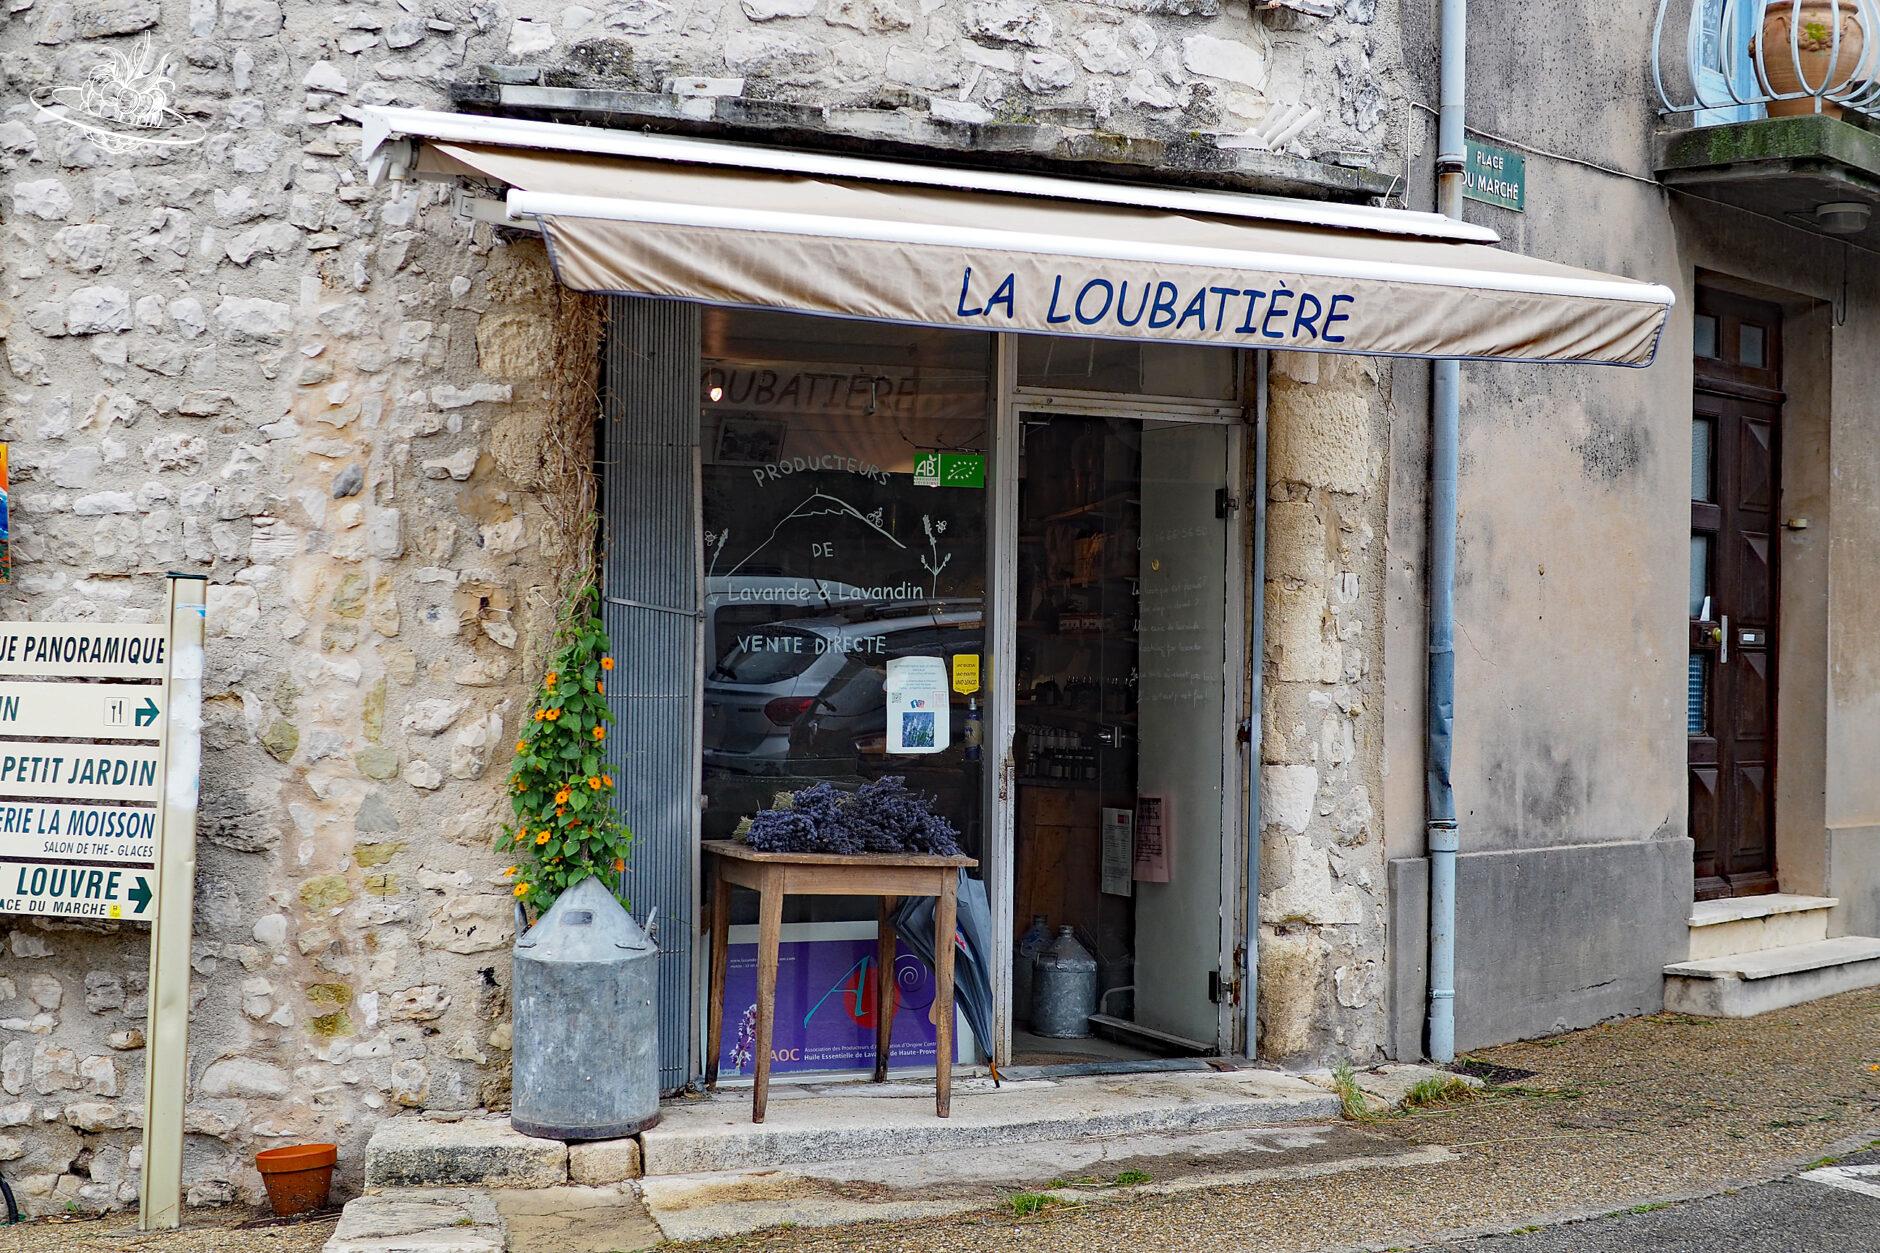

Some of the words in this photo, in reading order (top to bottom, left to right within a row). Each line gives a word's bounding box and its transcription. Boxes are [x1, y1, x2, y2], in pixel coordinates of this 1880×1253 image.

[1476, 150, 1505, 171] PLACE
[1477, 174, 1519, 200] MARCHÉ
[956, 266, 1016, 319] LA
[1046, 273, 1356, 344] LOUBATIÈRE
[752, 454, 892, 488] PRODUCTEURS
[915, 459, 936, 477] AB
[812, 541, 835, 559] DE
[727, 582, 811, 602] Lavande
[817, 583, 832, 601] &
[838, 580, 925, 601] Lavandin
[23, 636, 165, 665] PANORAMIQUE
[737, 635, 803, 654] VENTE
[814, 634, 887, 656] DIRECTE
[0, 756, 64, 783] PETIT
[67, 758, 158, 787] JARDIN
[37, 808, 61, 835] LA
[66, 810, 156, 839] MOISSON
[43, 841, 75, 855] SALON
[76, 842, 90, 855] DE
[117, 844, 154, 858] GLACES
[16, 866, 122, 901] LOUVRE
[28, 900, 47, 912] DU
[52, 902, 107, 916] MARCHE
[821, 1052, 855, 1060] Essentielle
